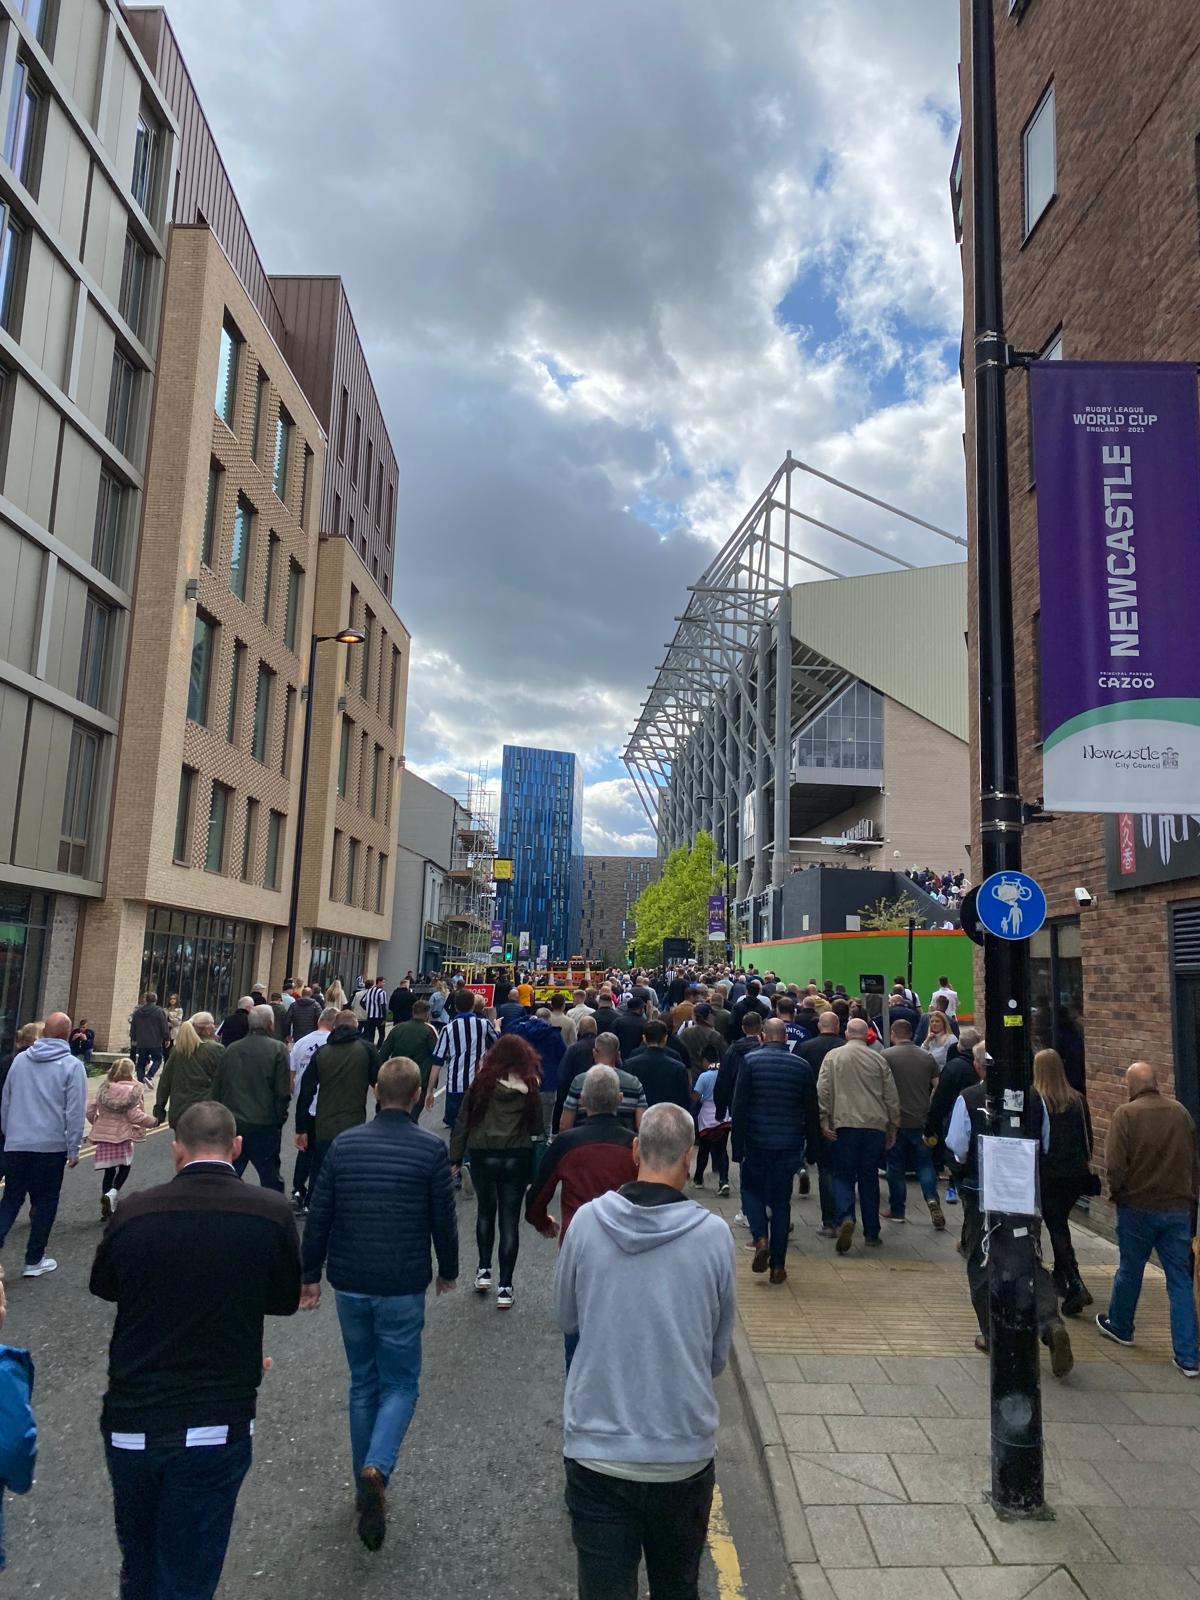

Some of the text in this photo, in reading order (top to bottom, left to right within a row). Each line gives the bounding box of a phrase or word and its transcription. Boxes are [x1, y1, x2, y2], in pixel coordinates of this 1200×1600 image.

[1073, 414, 1158, 426] WORLD CUP
[1102, 445, 1140, 657] NEWCASTLE
[1098, 677, 1155, 689] CAZOO
[1083, 744, 1160, 761] Newcastle
